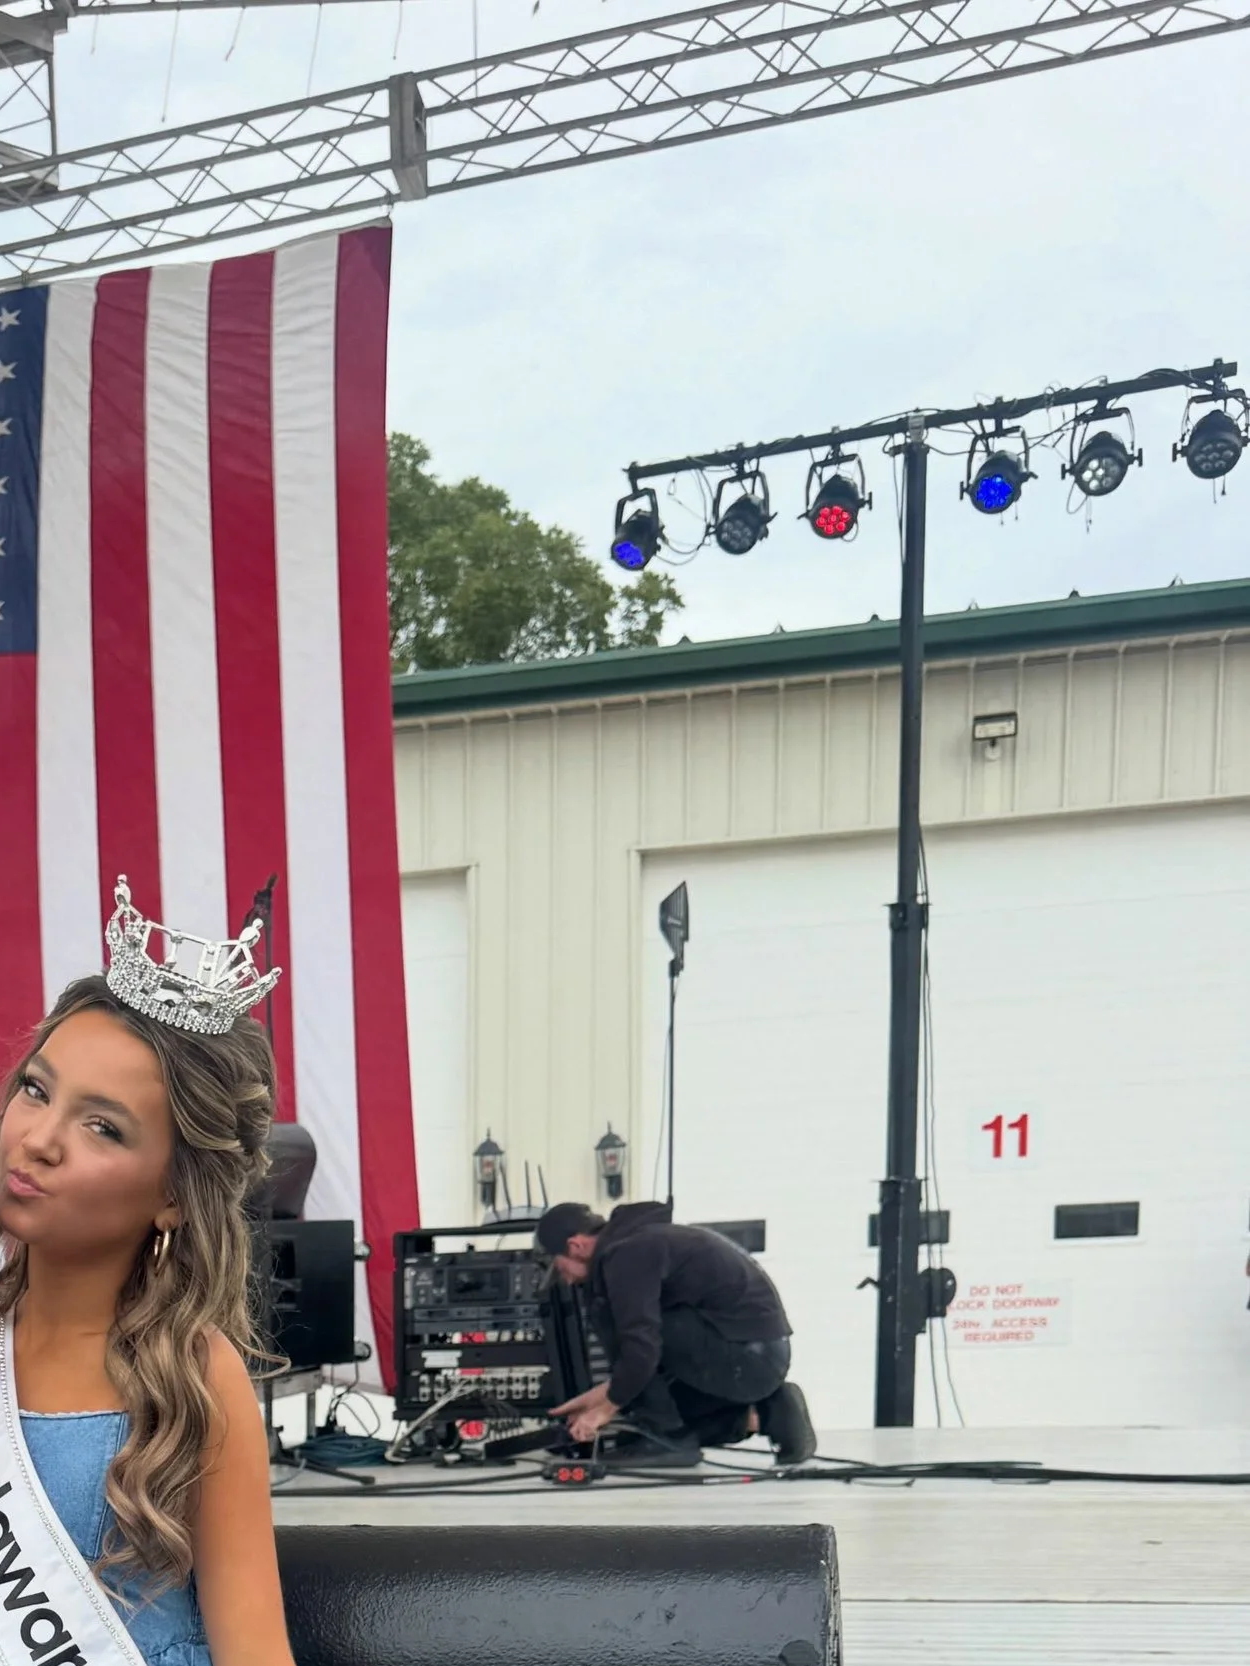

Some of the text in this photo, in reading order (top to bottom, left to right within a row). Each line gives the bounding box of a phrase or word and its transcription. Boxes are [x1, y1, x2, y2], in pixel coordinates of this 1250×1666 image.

[981, 1113, 1029, 1158] 11
[970, 1284, 1023, 1297] DO NOT
[992, 1297, 1060, 1310] DOORWAY
[992, 1317, 1047, 1328] ACCESS
[964, 1331, 1034, 1342] REQUIRED
